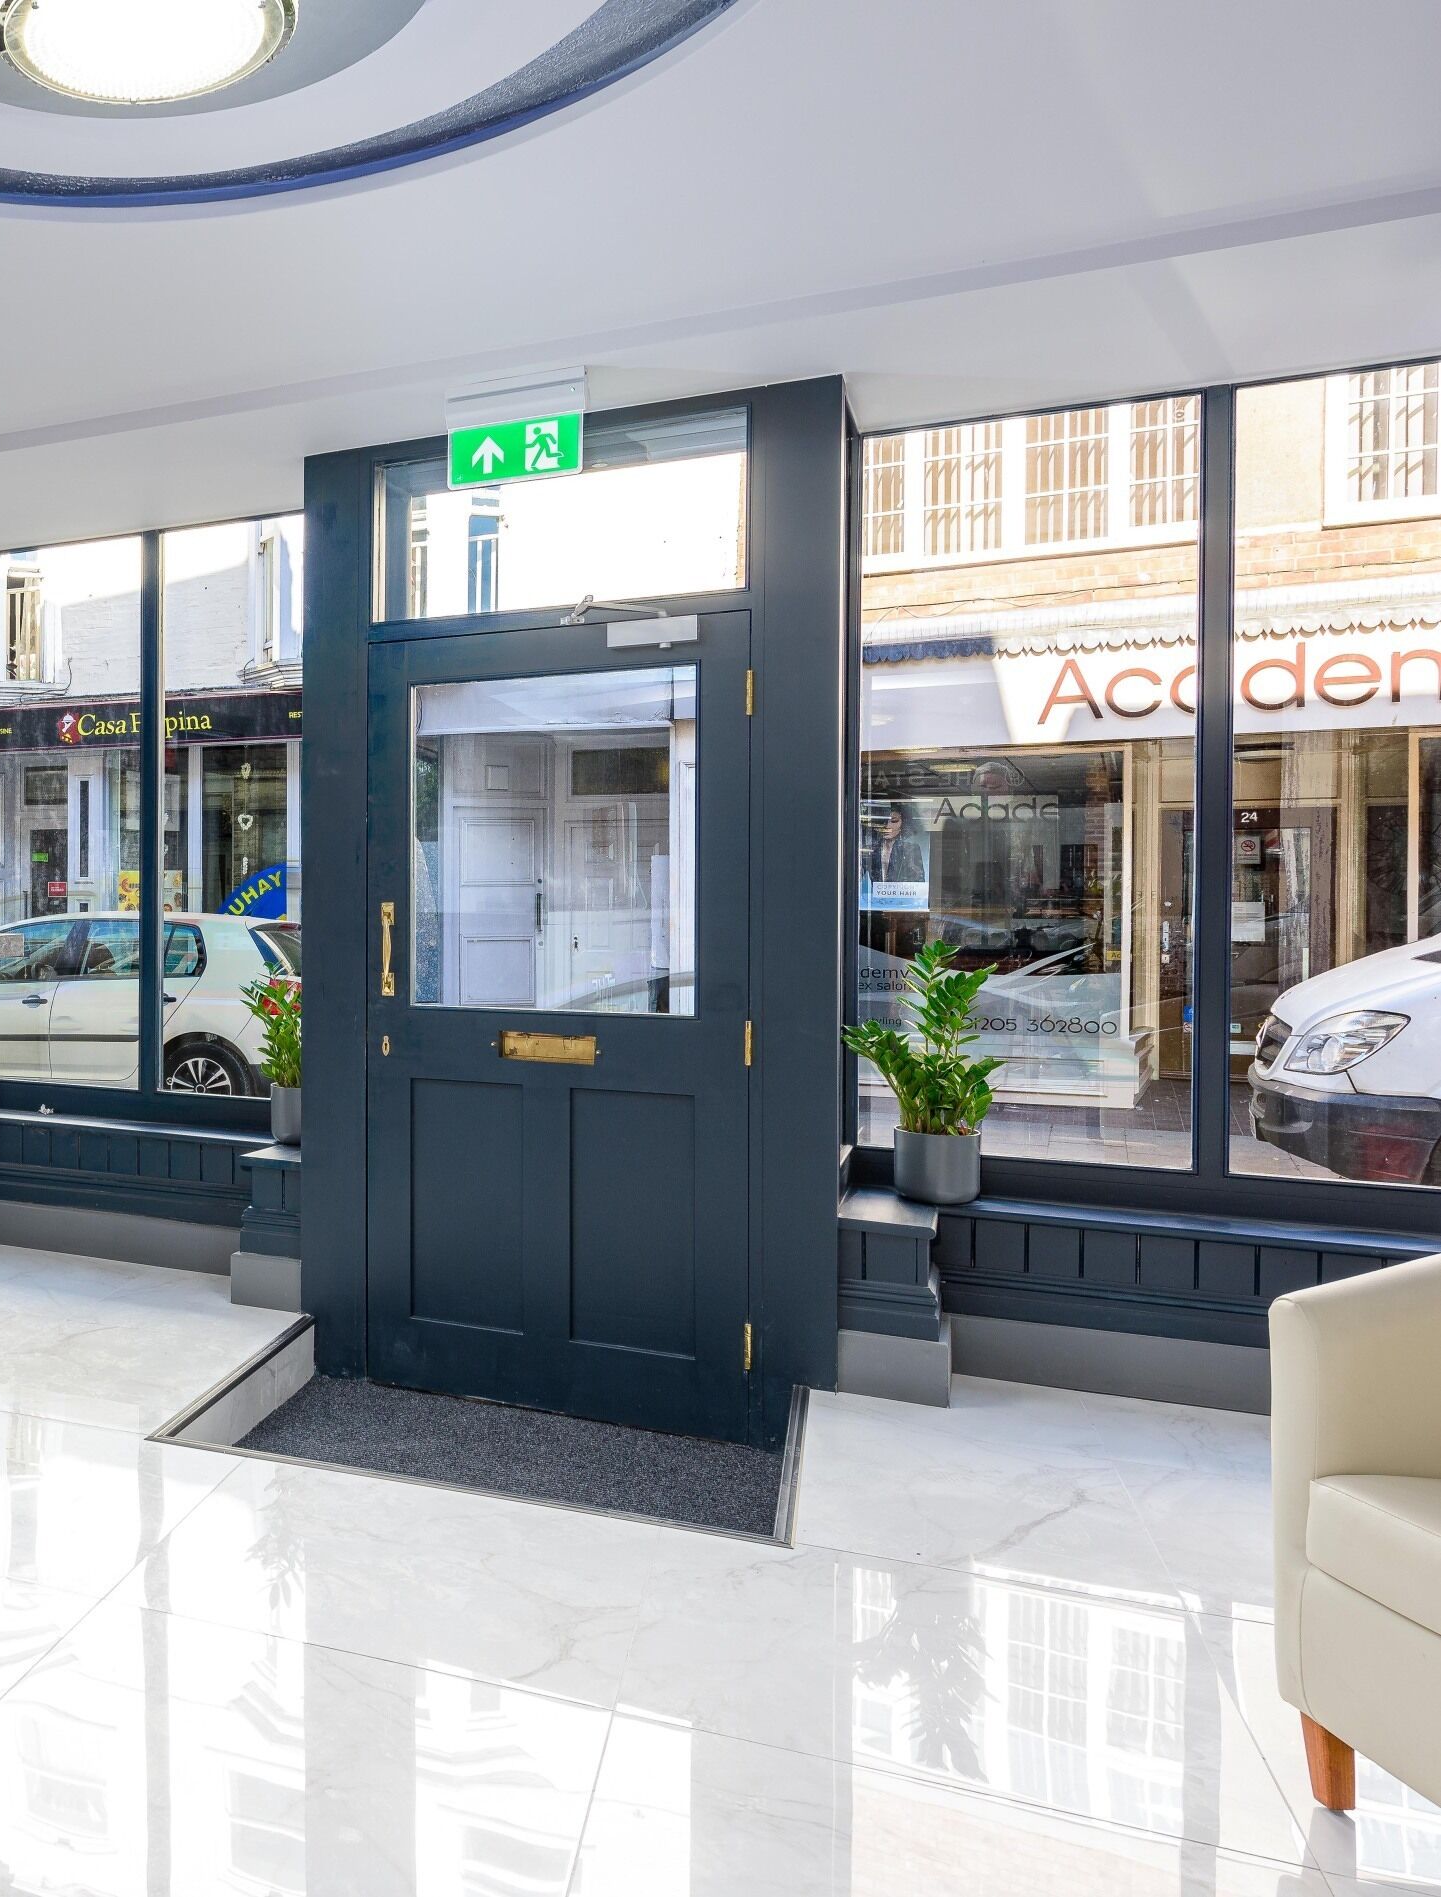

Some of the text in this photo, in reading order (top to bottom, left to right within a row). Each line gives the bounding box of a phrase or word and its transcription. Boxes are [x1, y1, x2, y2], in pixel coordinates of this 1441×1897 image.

[77, 713, 126, 736] Casa
[1241, 812, 1258, 823] 24
[224, 871, 281, 916] UHAY
[1027, 1014, 1118, 1035] 362800
